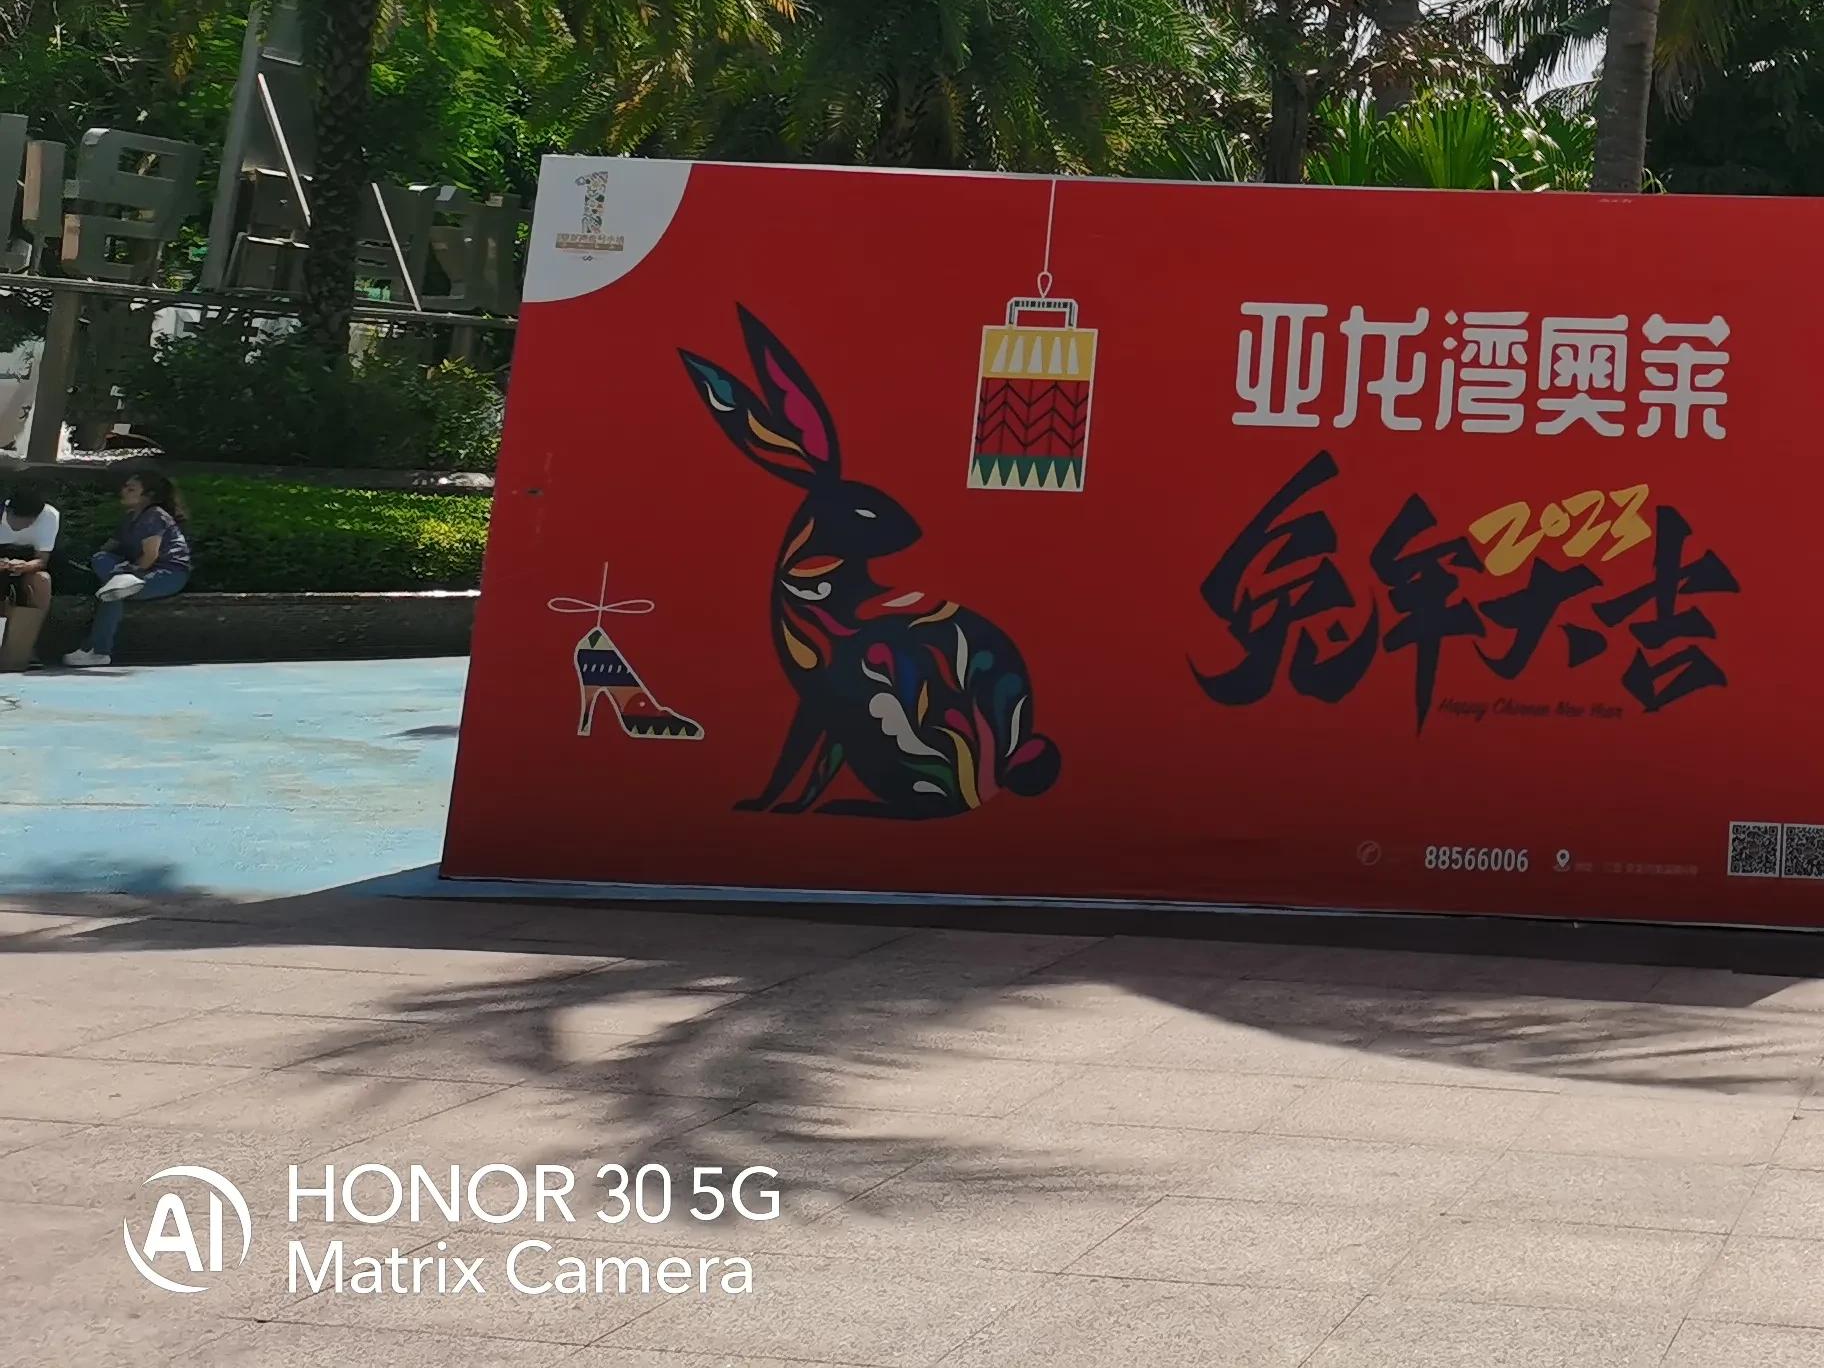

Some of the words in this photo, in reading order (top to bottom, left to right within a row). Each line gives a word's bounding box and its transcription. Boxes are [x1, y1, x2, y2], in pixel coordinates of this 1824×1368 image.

[1232, 301, 1731, 440] 亚龙湾奥莱
[1468, 483, 1652, 576] 2023
[1185, 450, 1740, 738] 兔年大吉
[1424, 845, 1529, 873] 88566006
